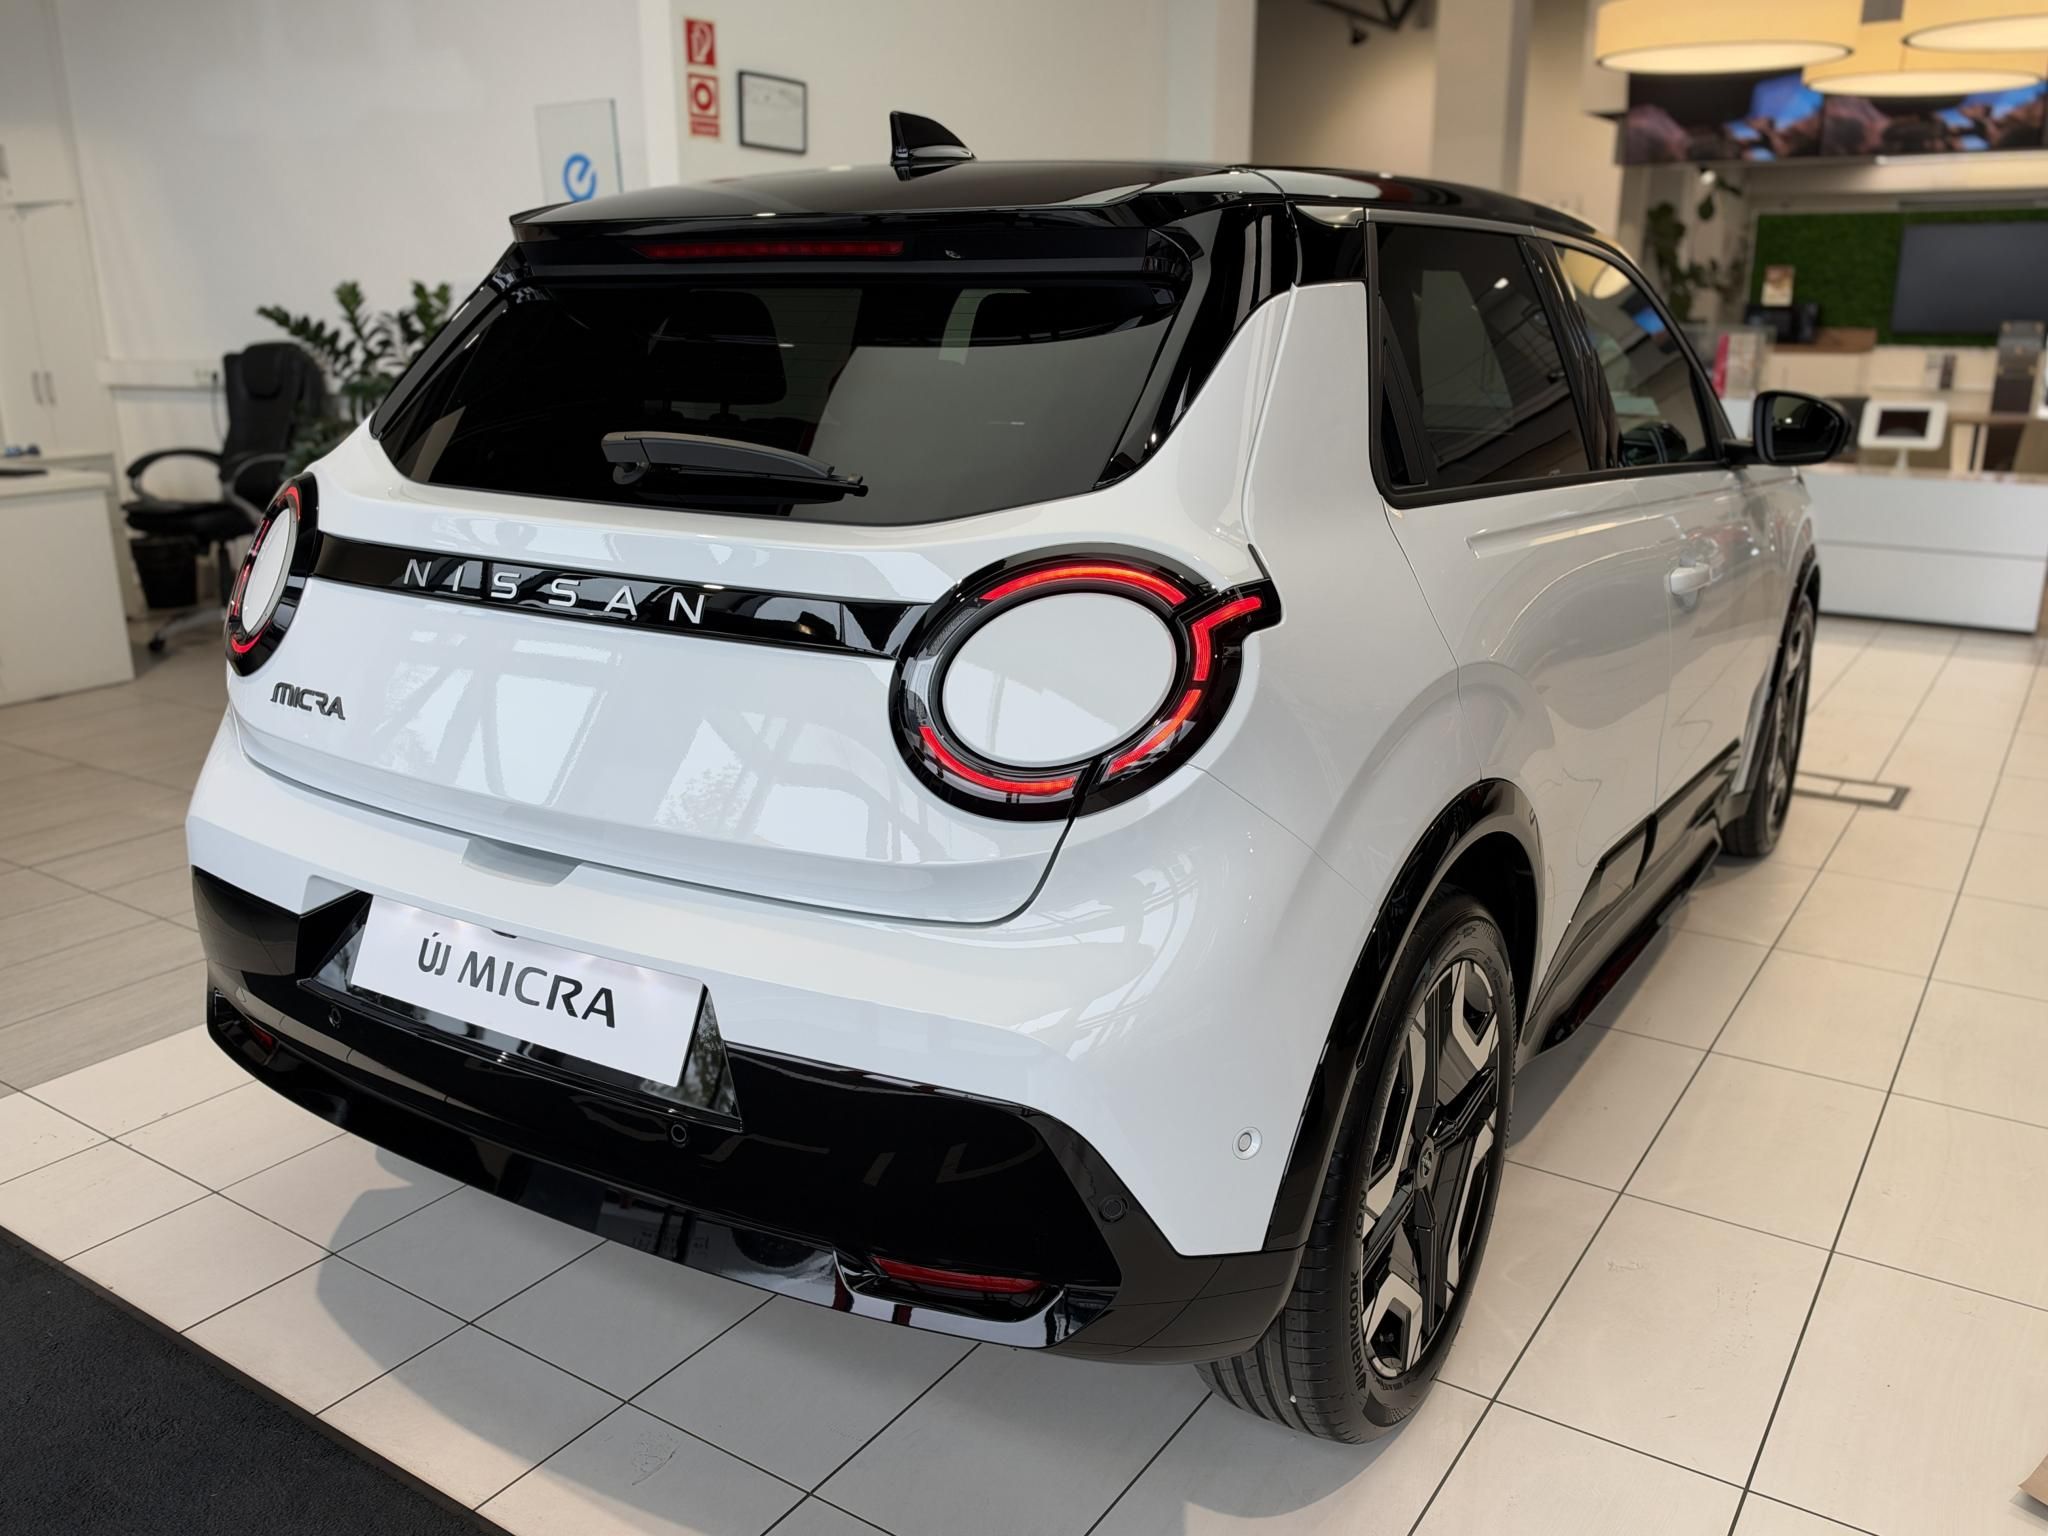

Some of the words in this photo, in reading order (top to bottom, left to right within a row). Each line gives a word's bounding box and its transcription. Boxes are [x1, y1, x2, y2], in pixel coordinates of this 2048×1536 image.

[403, 559, 705, 625] NISSAN
[270, 682, 346, 721] MICRA
[417, 932, 452, 976] ÚJ
[457, 951, 616, 1029] MICRA
